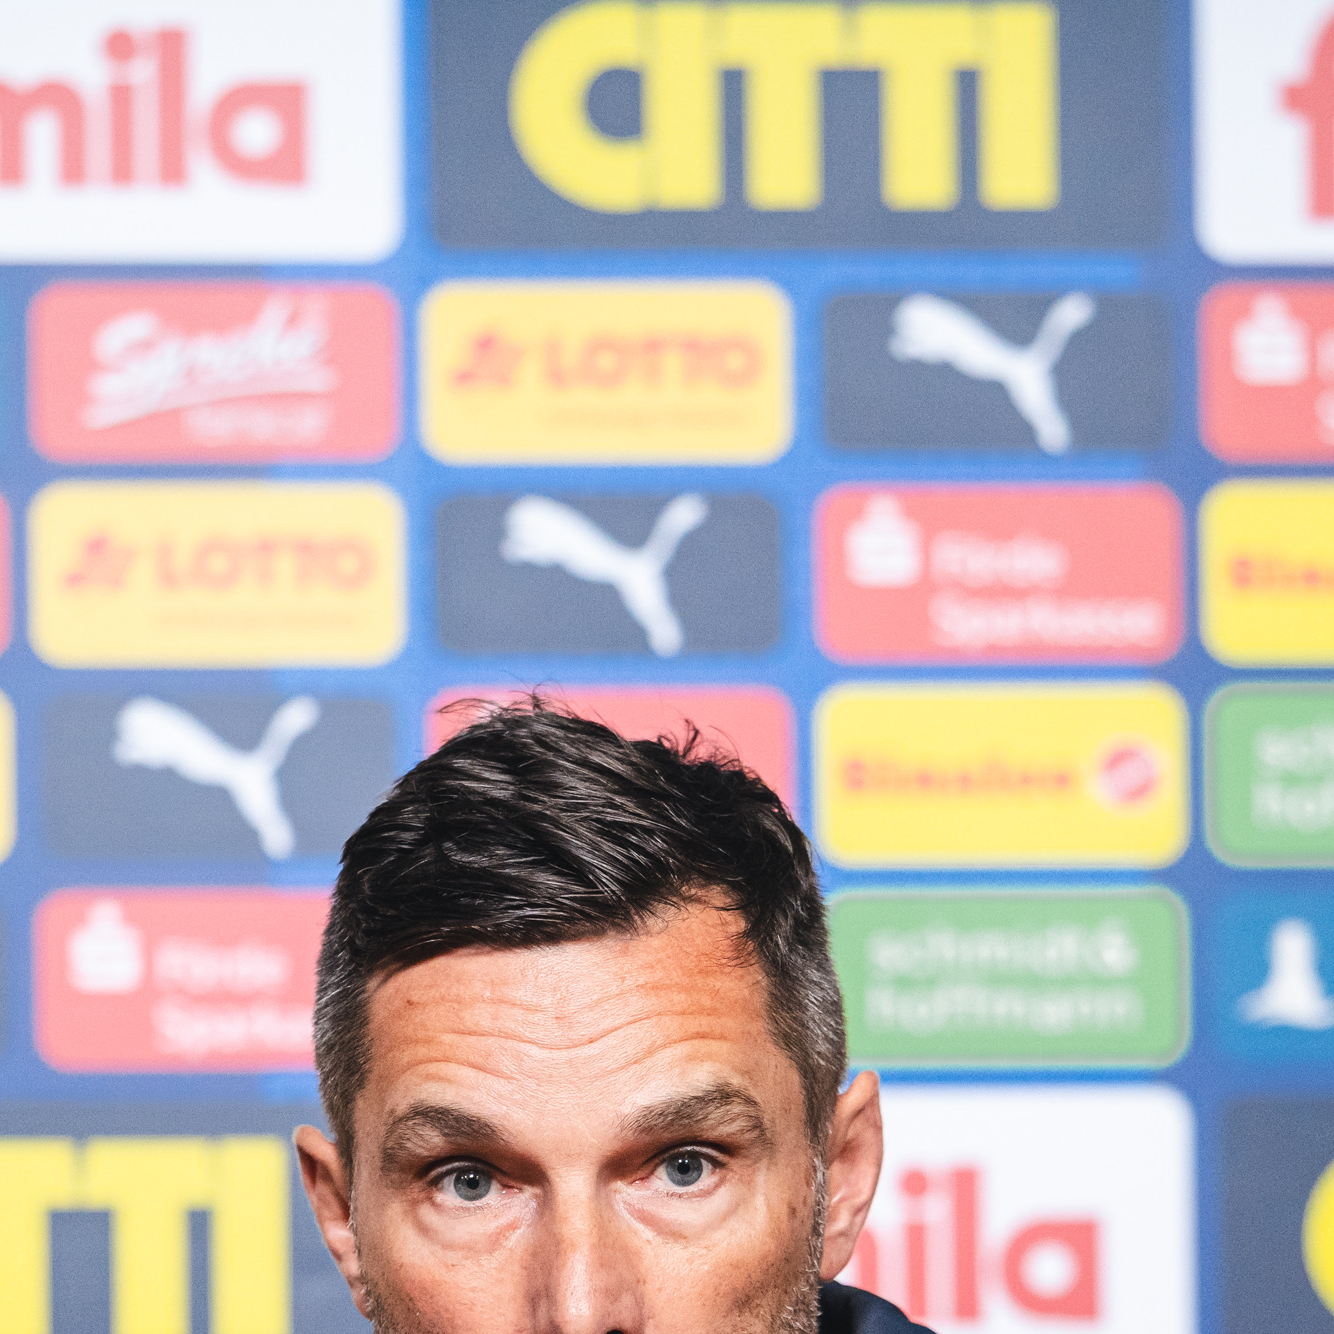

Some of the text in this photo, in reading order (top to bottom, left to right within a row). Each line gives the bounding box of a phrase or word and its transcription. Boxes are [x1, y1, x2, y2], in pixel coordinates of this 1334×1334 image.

[509, 0, 1061, 214] CITTI
[545, 332, 765, 389] LOTTO
[157, 534, 377, 592] LOTTO
